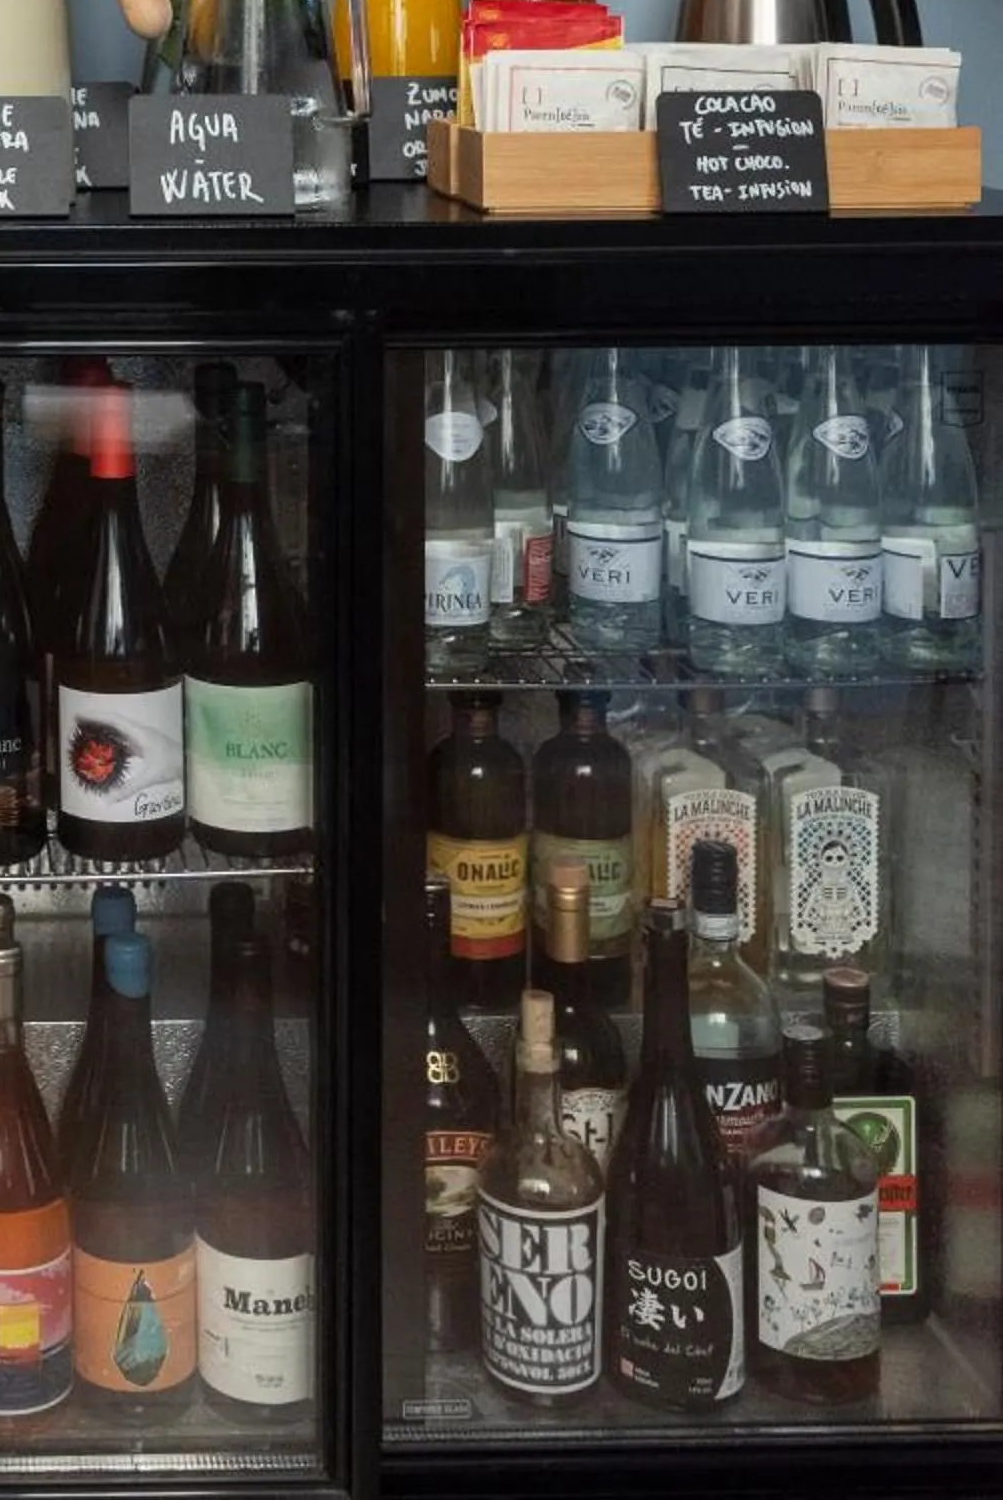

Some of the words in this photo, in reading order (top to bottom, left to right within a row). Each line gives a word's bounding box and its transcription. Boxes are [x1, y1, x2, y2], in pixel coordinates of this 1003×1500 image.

[169, 109, 239, 151] AGUA
[696, 155, 730, 174] HOT
[160, 167, 265, 205] WATER
[578, 563, 631, 585] VERI
[225, 741, 289, 760] BLANC
[628, 1259, 707, 1291] SUGOI
